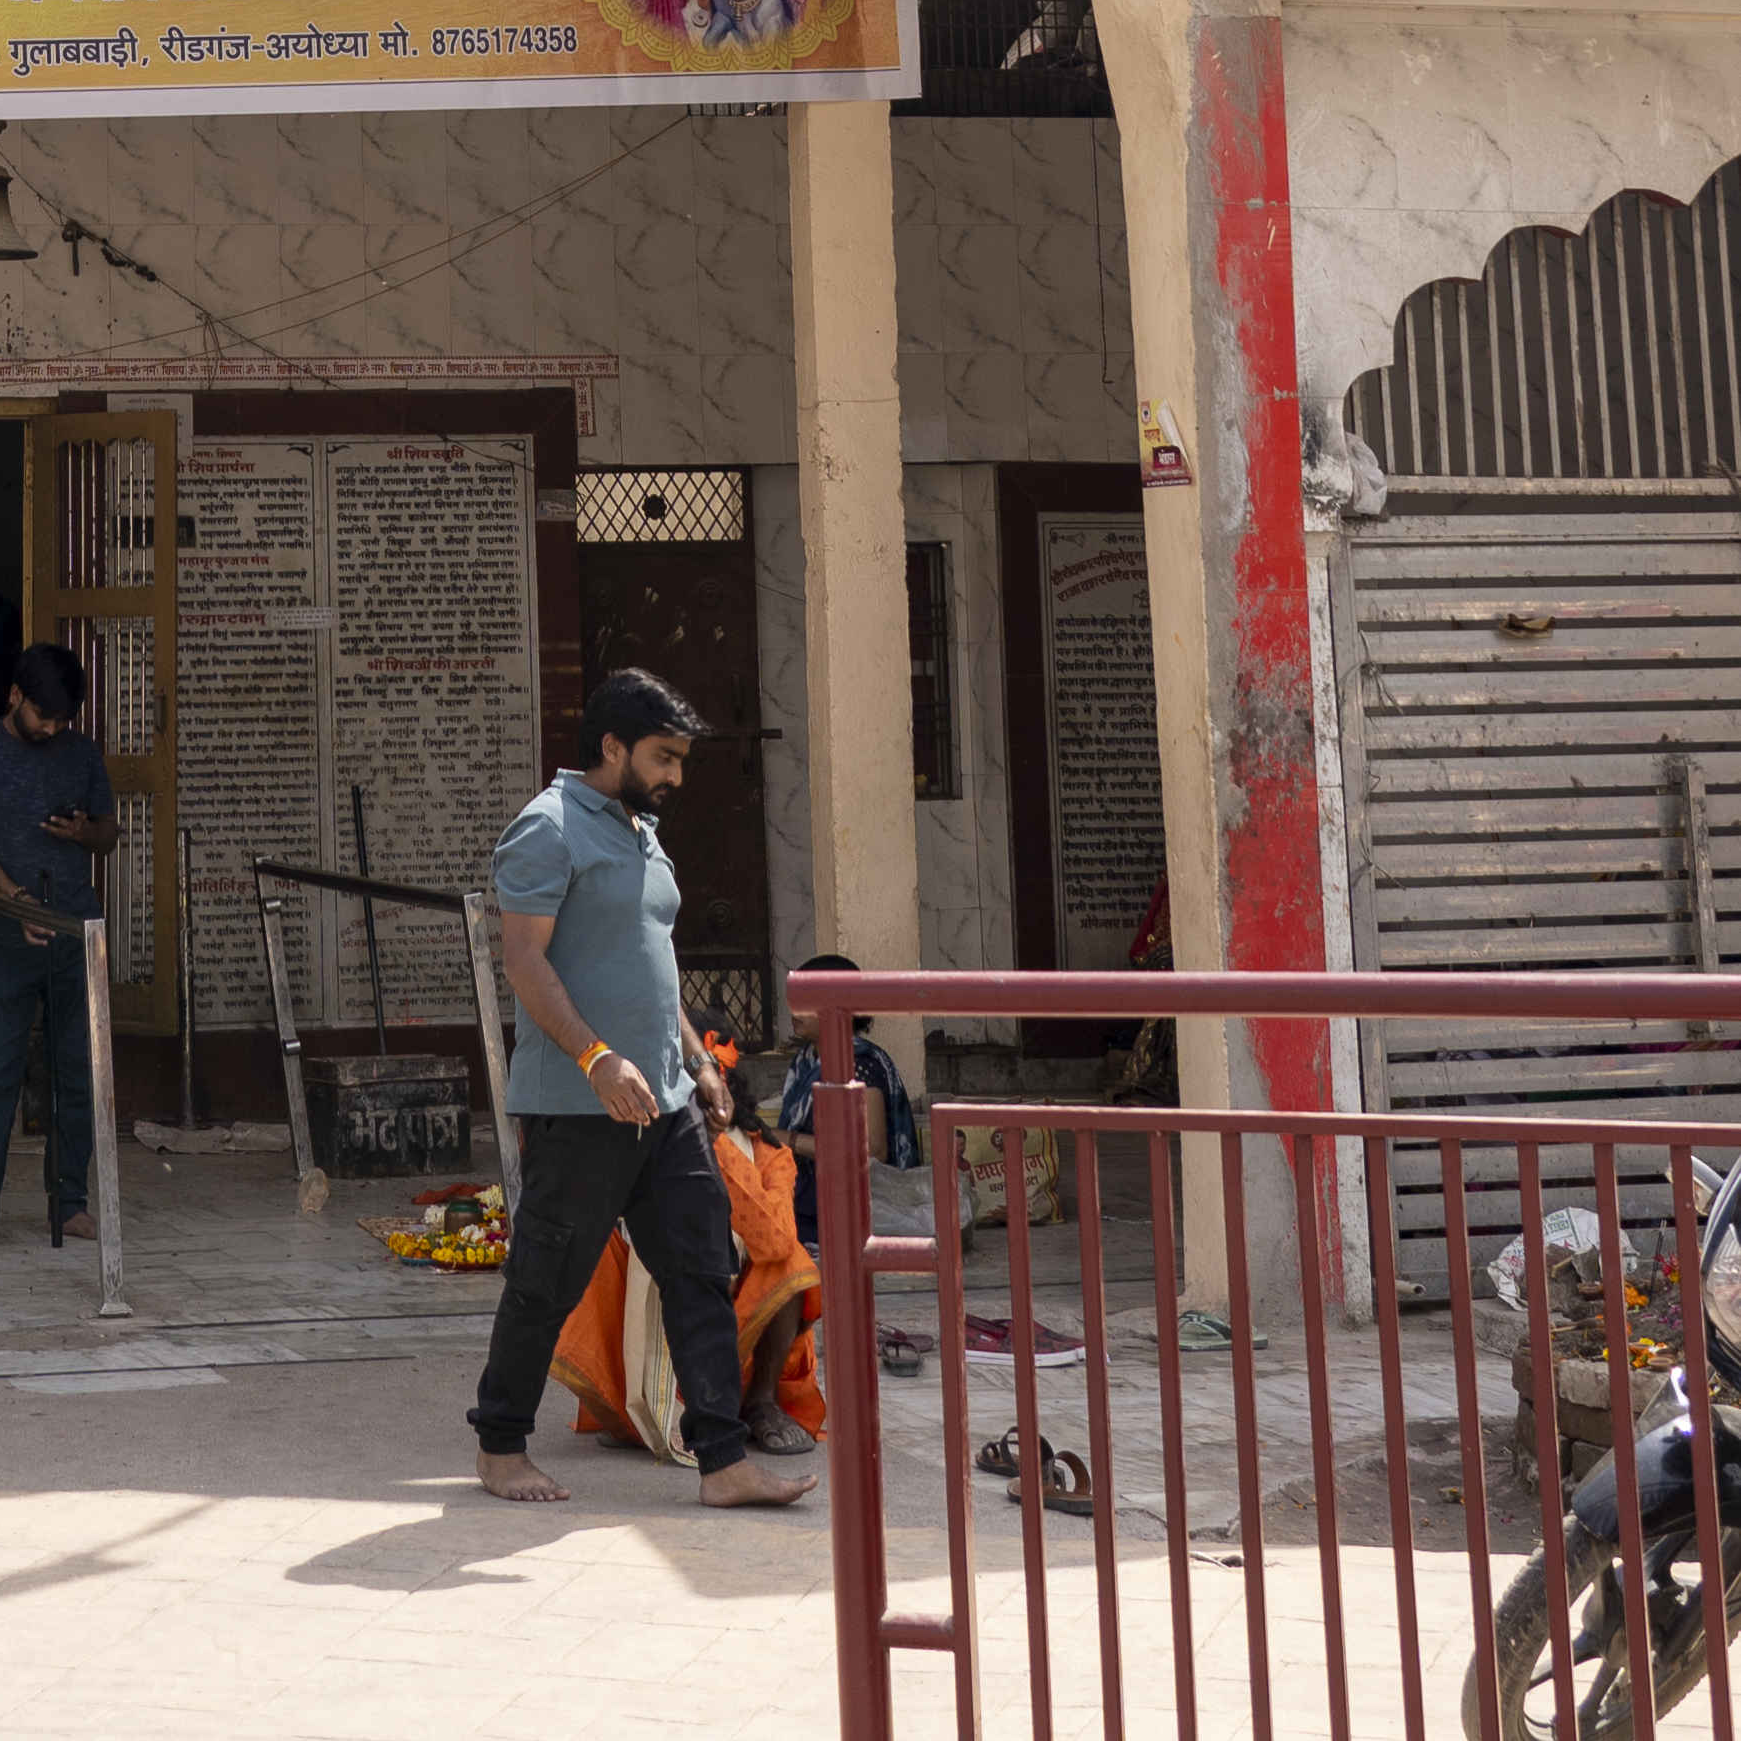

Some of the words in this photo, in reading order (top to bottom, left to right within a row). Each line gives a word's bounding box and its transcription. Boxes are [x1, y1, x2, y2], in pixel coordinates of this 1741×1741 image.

[9, 27, 149, 76] गुलाबबाड़ी,
[379, 21, 418, 58] मो.
[431, 24, 578, 56] 8765174358
[387, 448, 403, 460] श्री
